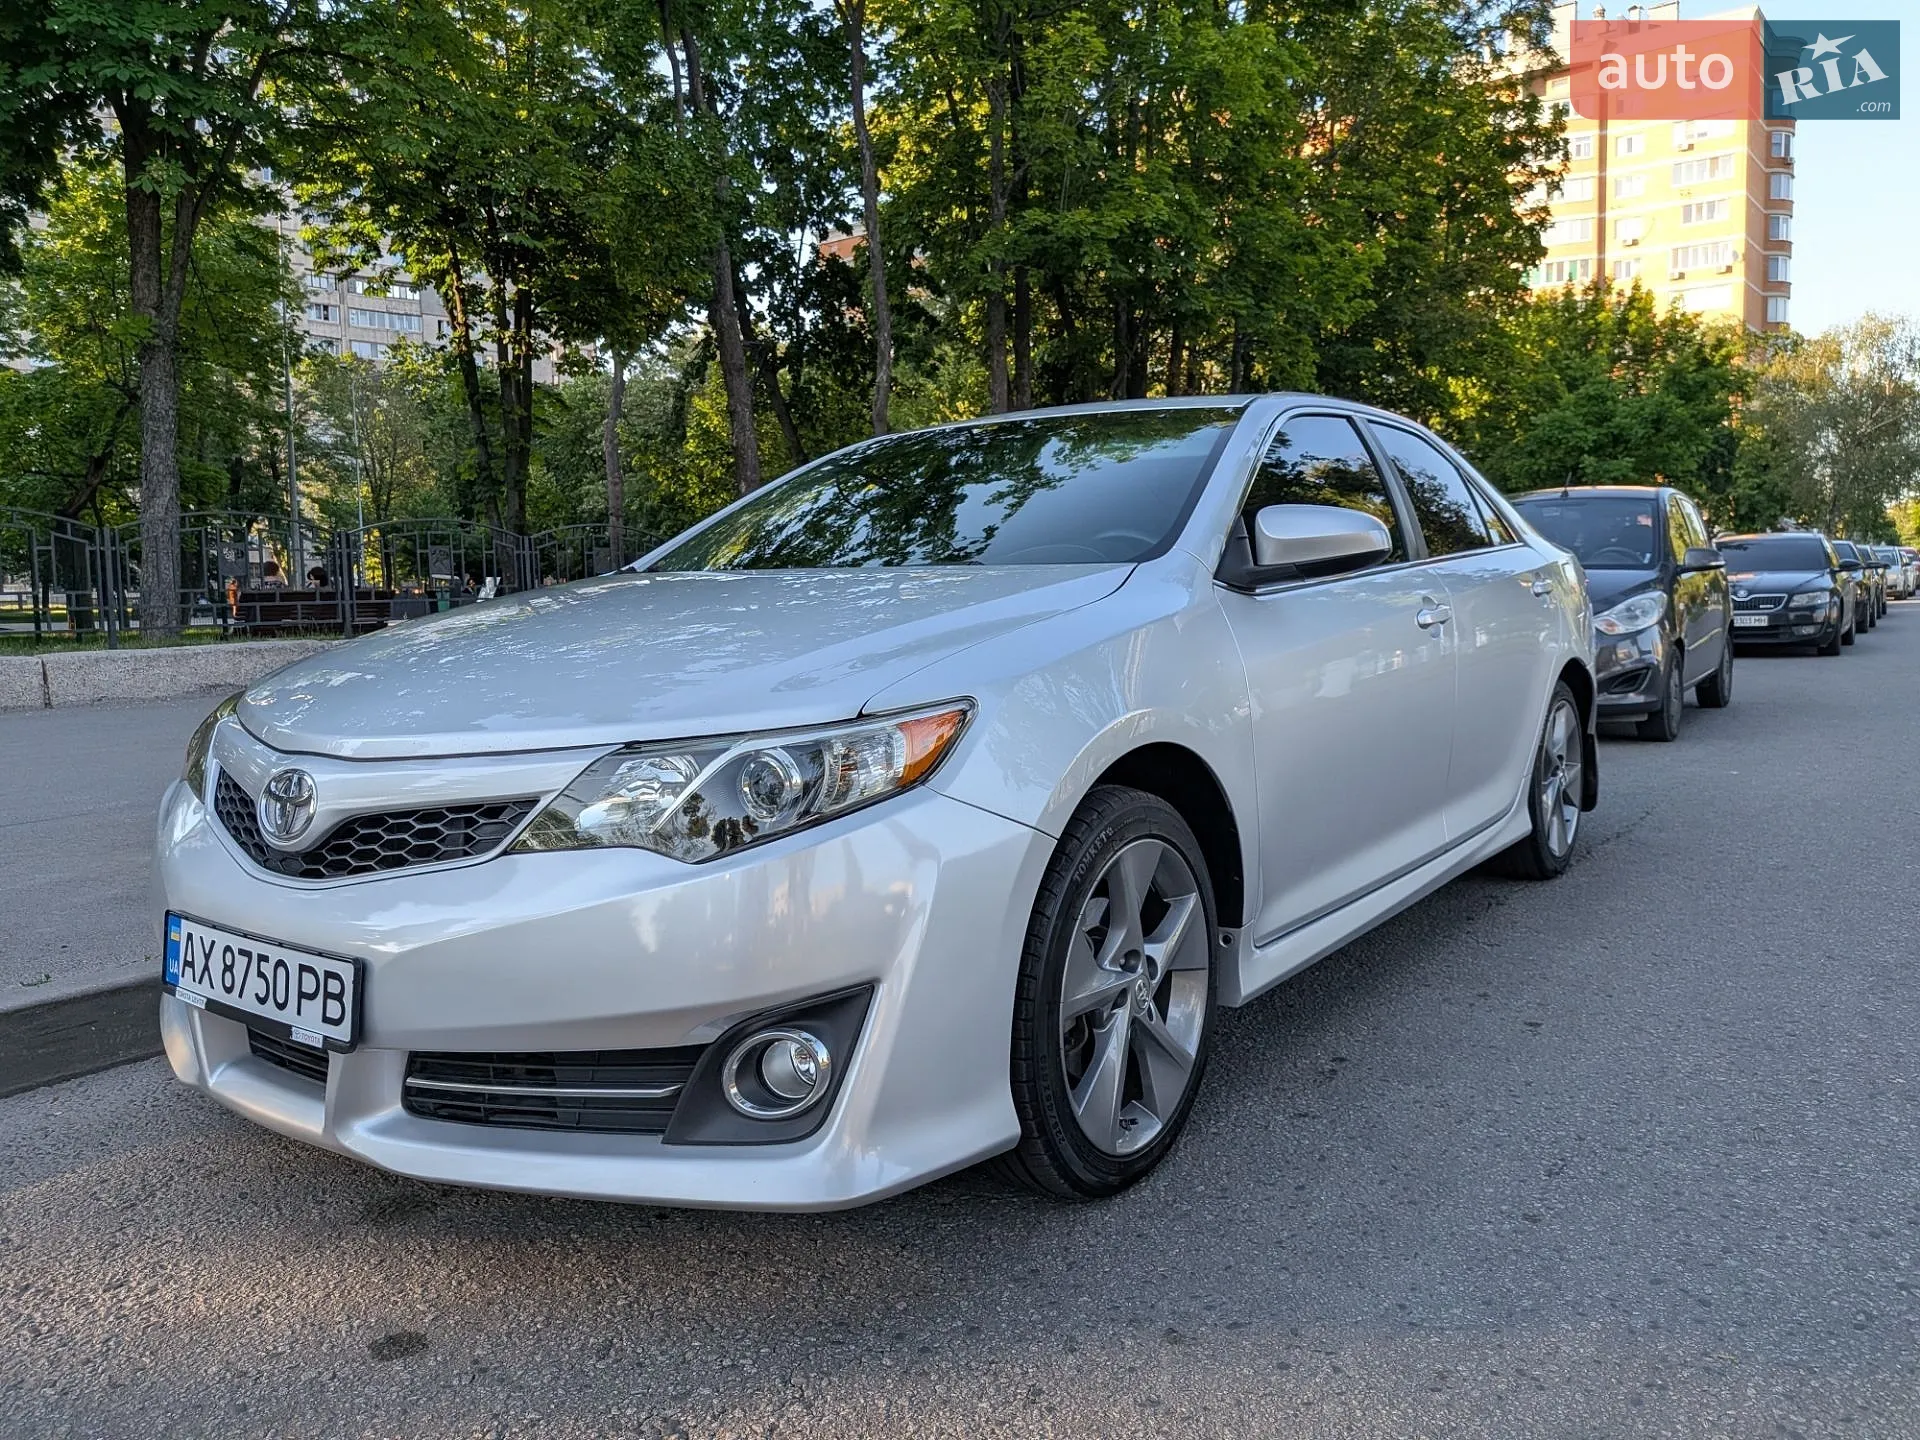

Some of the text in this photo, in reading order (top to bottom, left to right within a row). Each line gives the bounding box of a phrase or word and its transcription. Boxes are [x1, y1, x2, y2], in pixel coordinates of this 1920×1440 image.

[169, 957, 180, 976] UA
[181, 931, 347, 1027] AX 8750 PB
